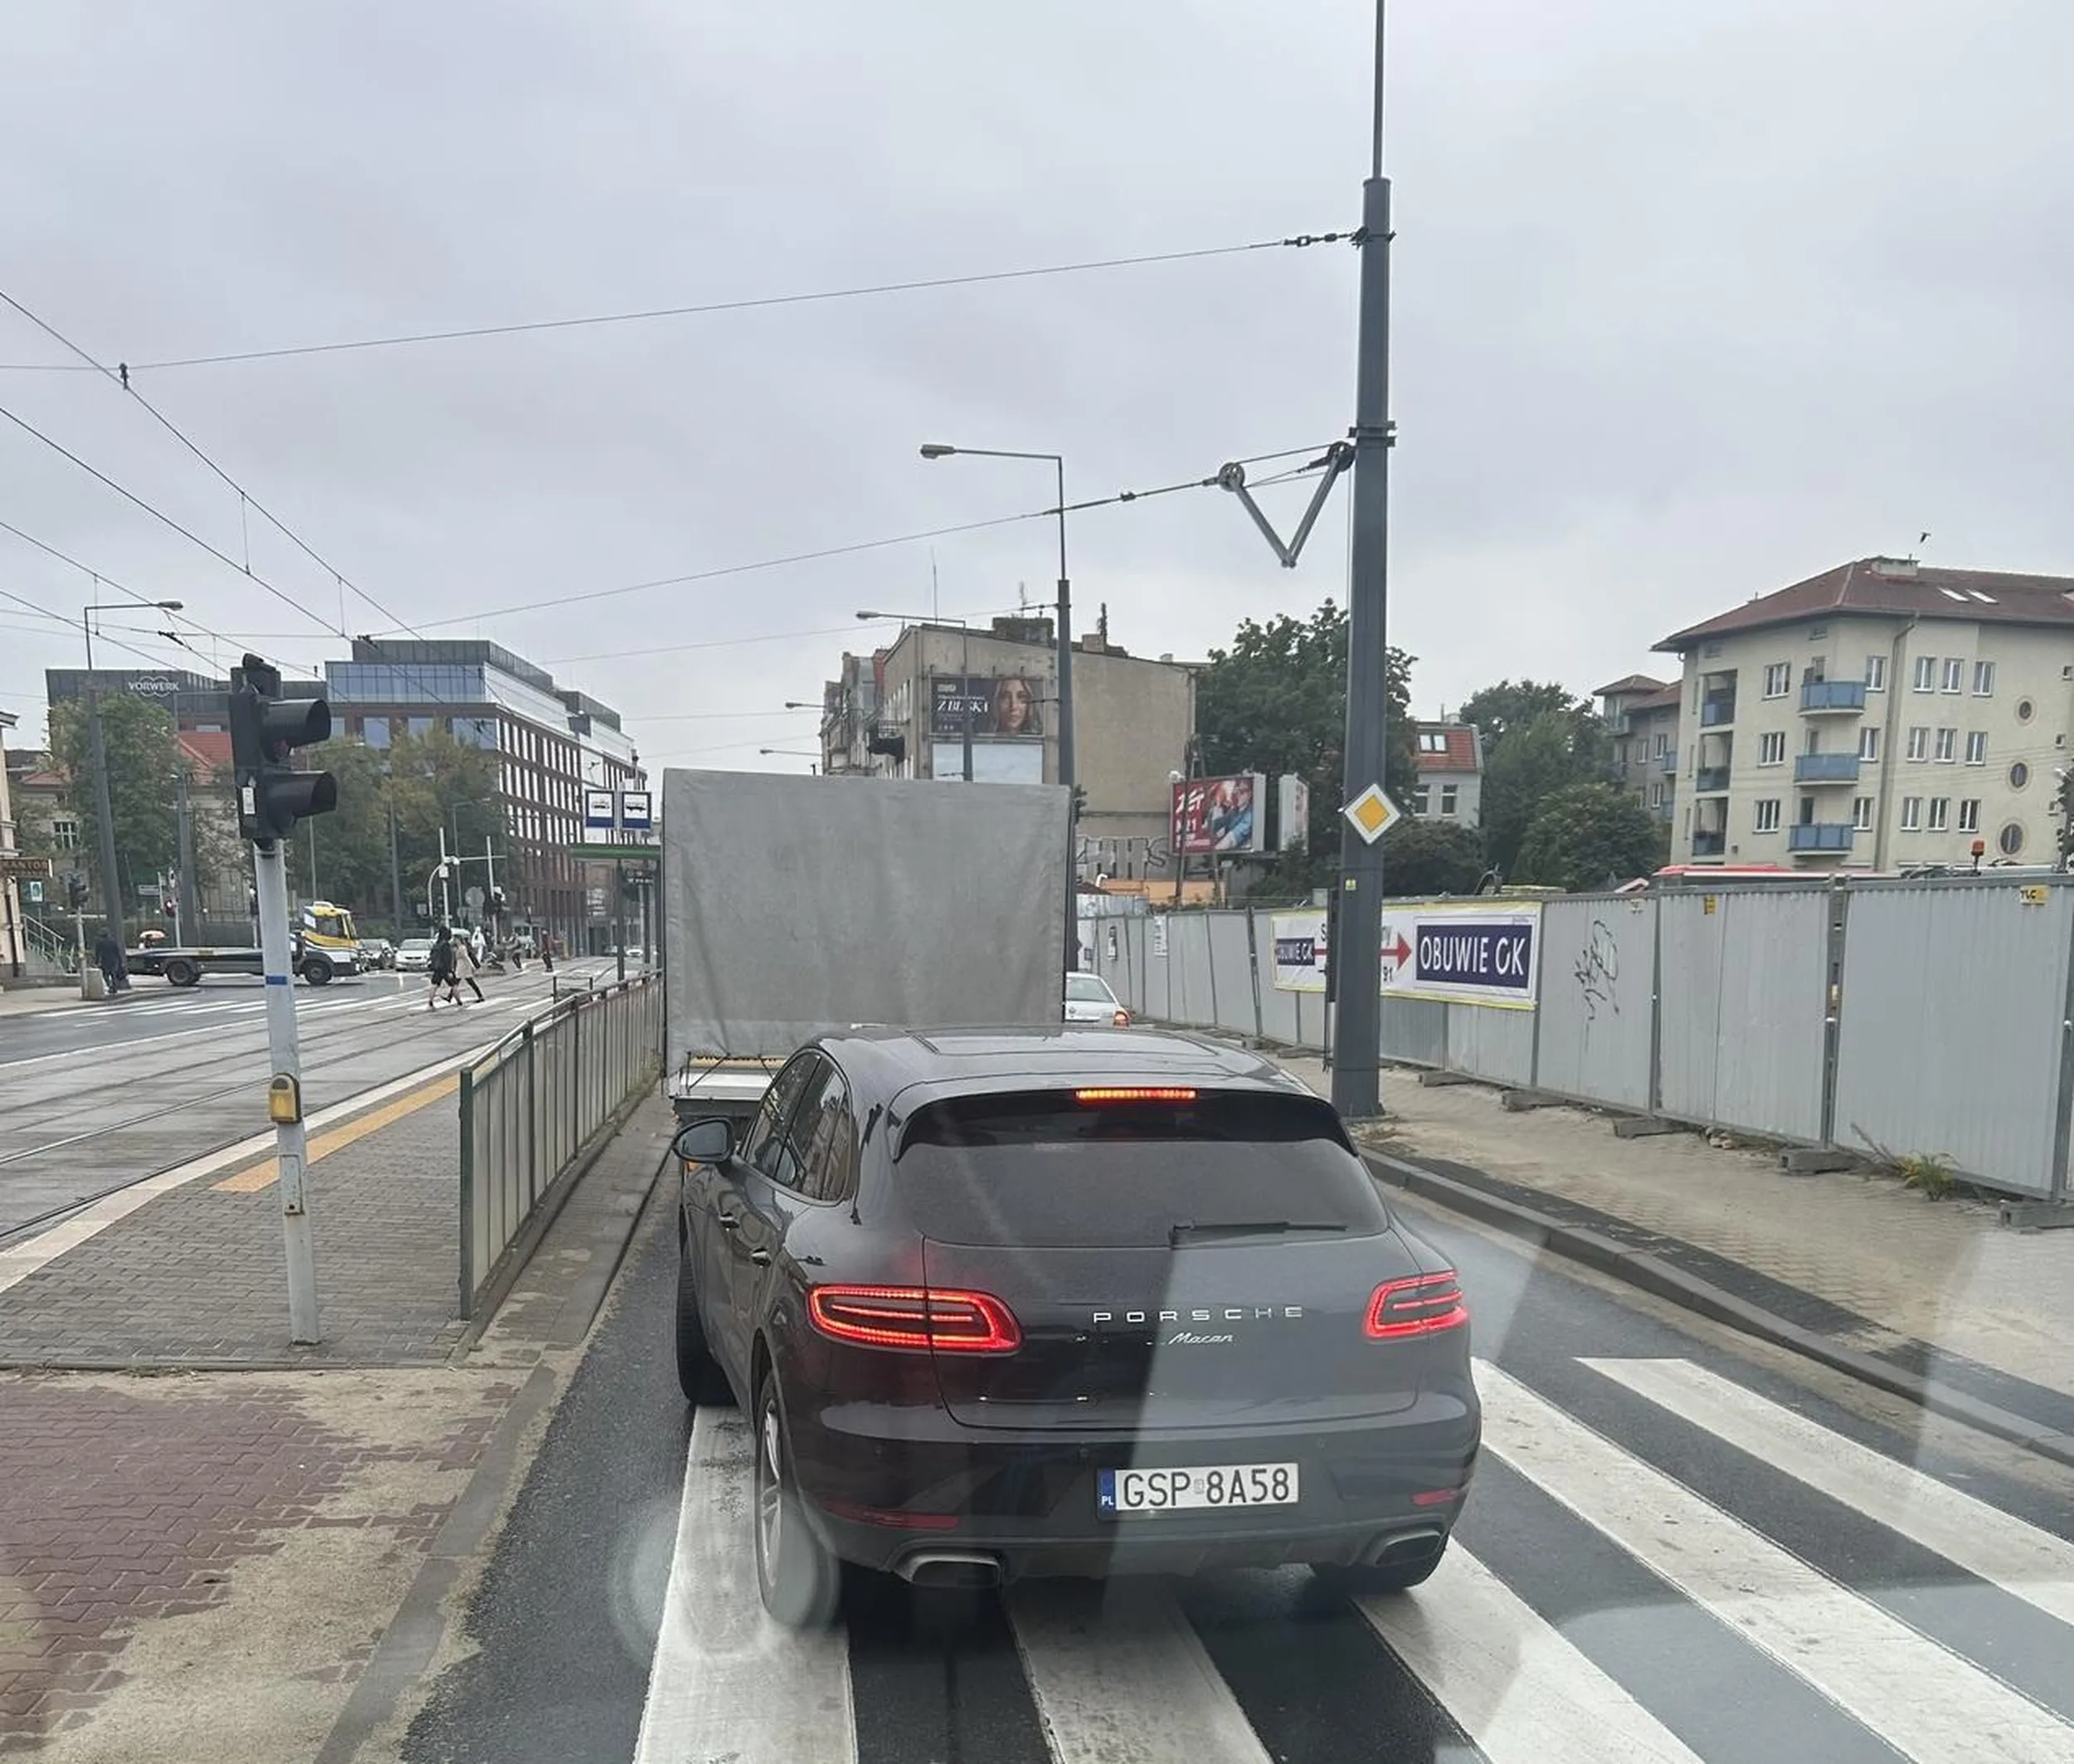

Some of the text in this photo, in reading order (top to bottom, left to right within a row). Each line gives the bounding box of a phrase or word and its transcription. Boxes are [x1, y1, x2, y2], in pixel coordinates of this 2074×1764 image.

[128, 681, 180, 691] VORWERK
[1419, 935, 1489, 973] OBUWIE
[1093, 1307, 1302, 1323] PORSCHE
[1168, 1332, 1234, 1345] Macan
[1123, 1467, 1290, 1508] GSP 8A58
[1101, 1495, 1115, 1507] PL
